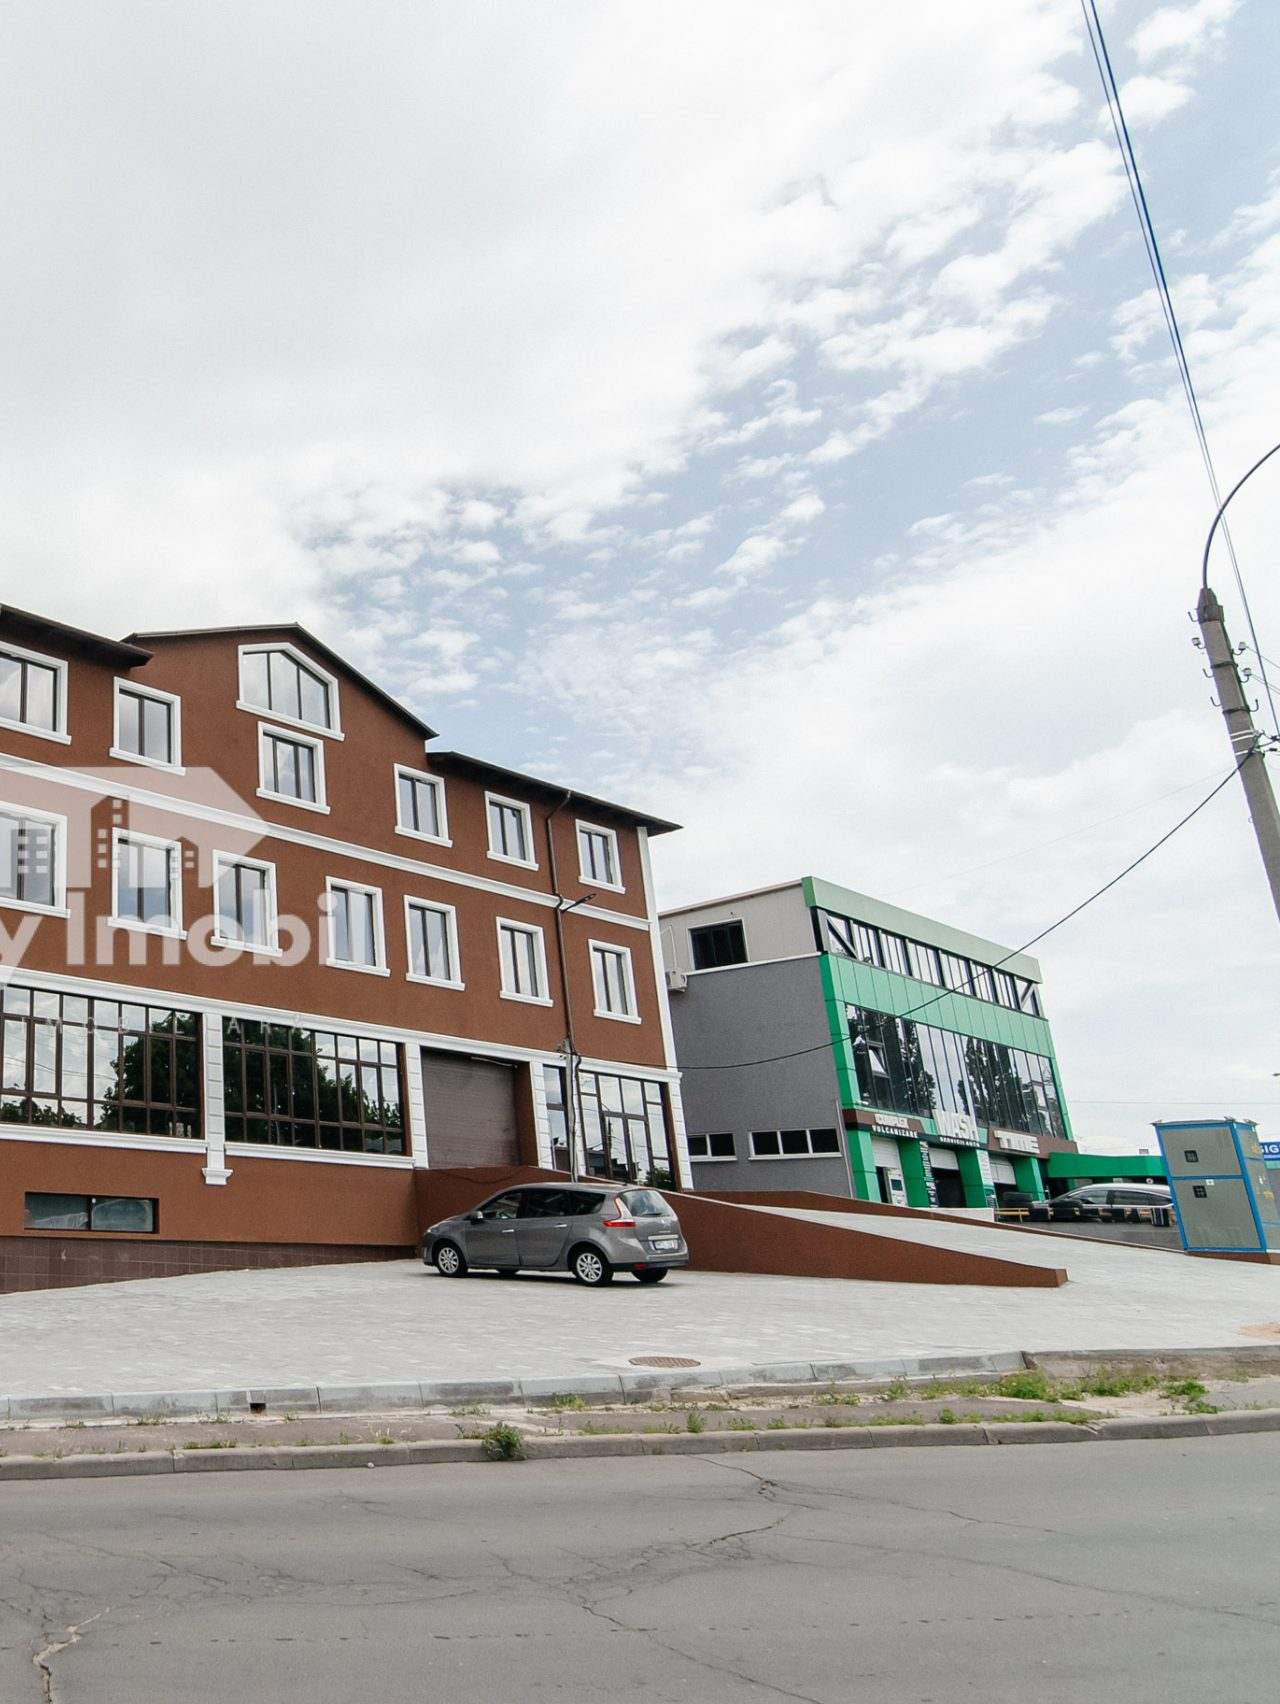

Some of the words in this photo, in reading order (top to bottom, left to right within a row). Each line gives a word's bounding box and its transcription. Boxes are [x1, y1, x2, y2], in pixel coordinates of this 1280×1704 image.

[872, 1124, 919, 1139] VULCANIZARE
[932, 1109, 980, 1142] WASH
[993, 1130, 1041, 1154] TIME
